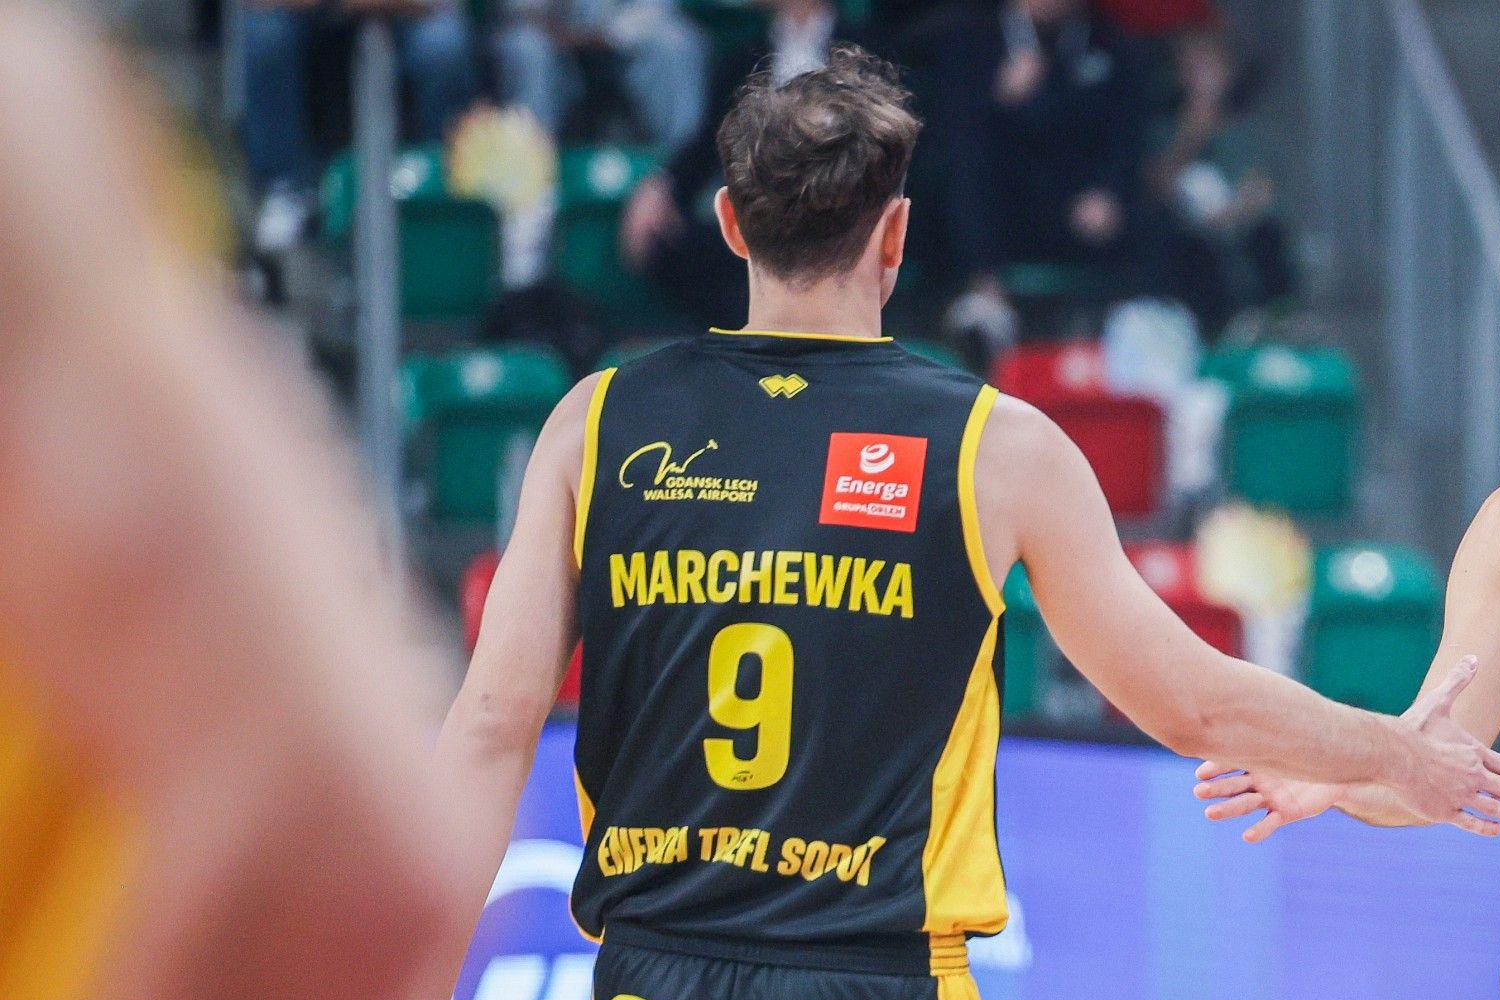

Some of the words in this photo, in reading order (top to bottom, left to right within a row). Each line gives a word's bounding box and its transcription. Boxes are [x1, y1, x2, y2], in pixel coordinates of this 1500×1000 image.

[644, 489, 694, 500] WALESA
[697, 489, 755, 502] AIRPORT
[666, 477, 722, 489] GDANSK
[724, 479, 758, 491] LECH
[836, 475, 909, 500] Energa
[609, 549, 914, 619] MARCHEWKA
[703, 622, 794, 790] 9
